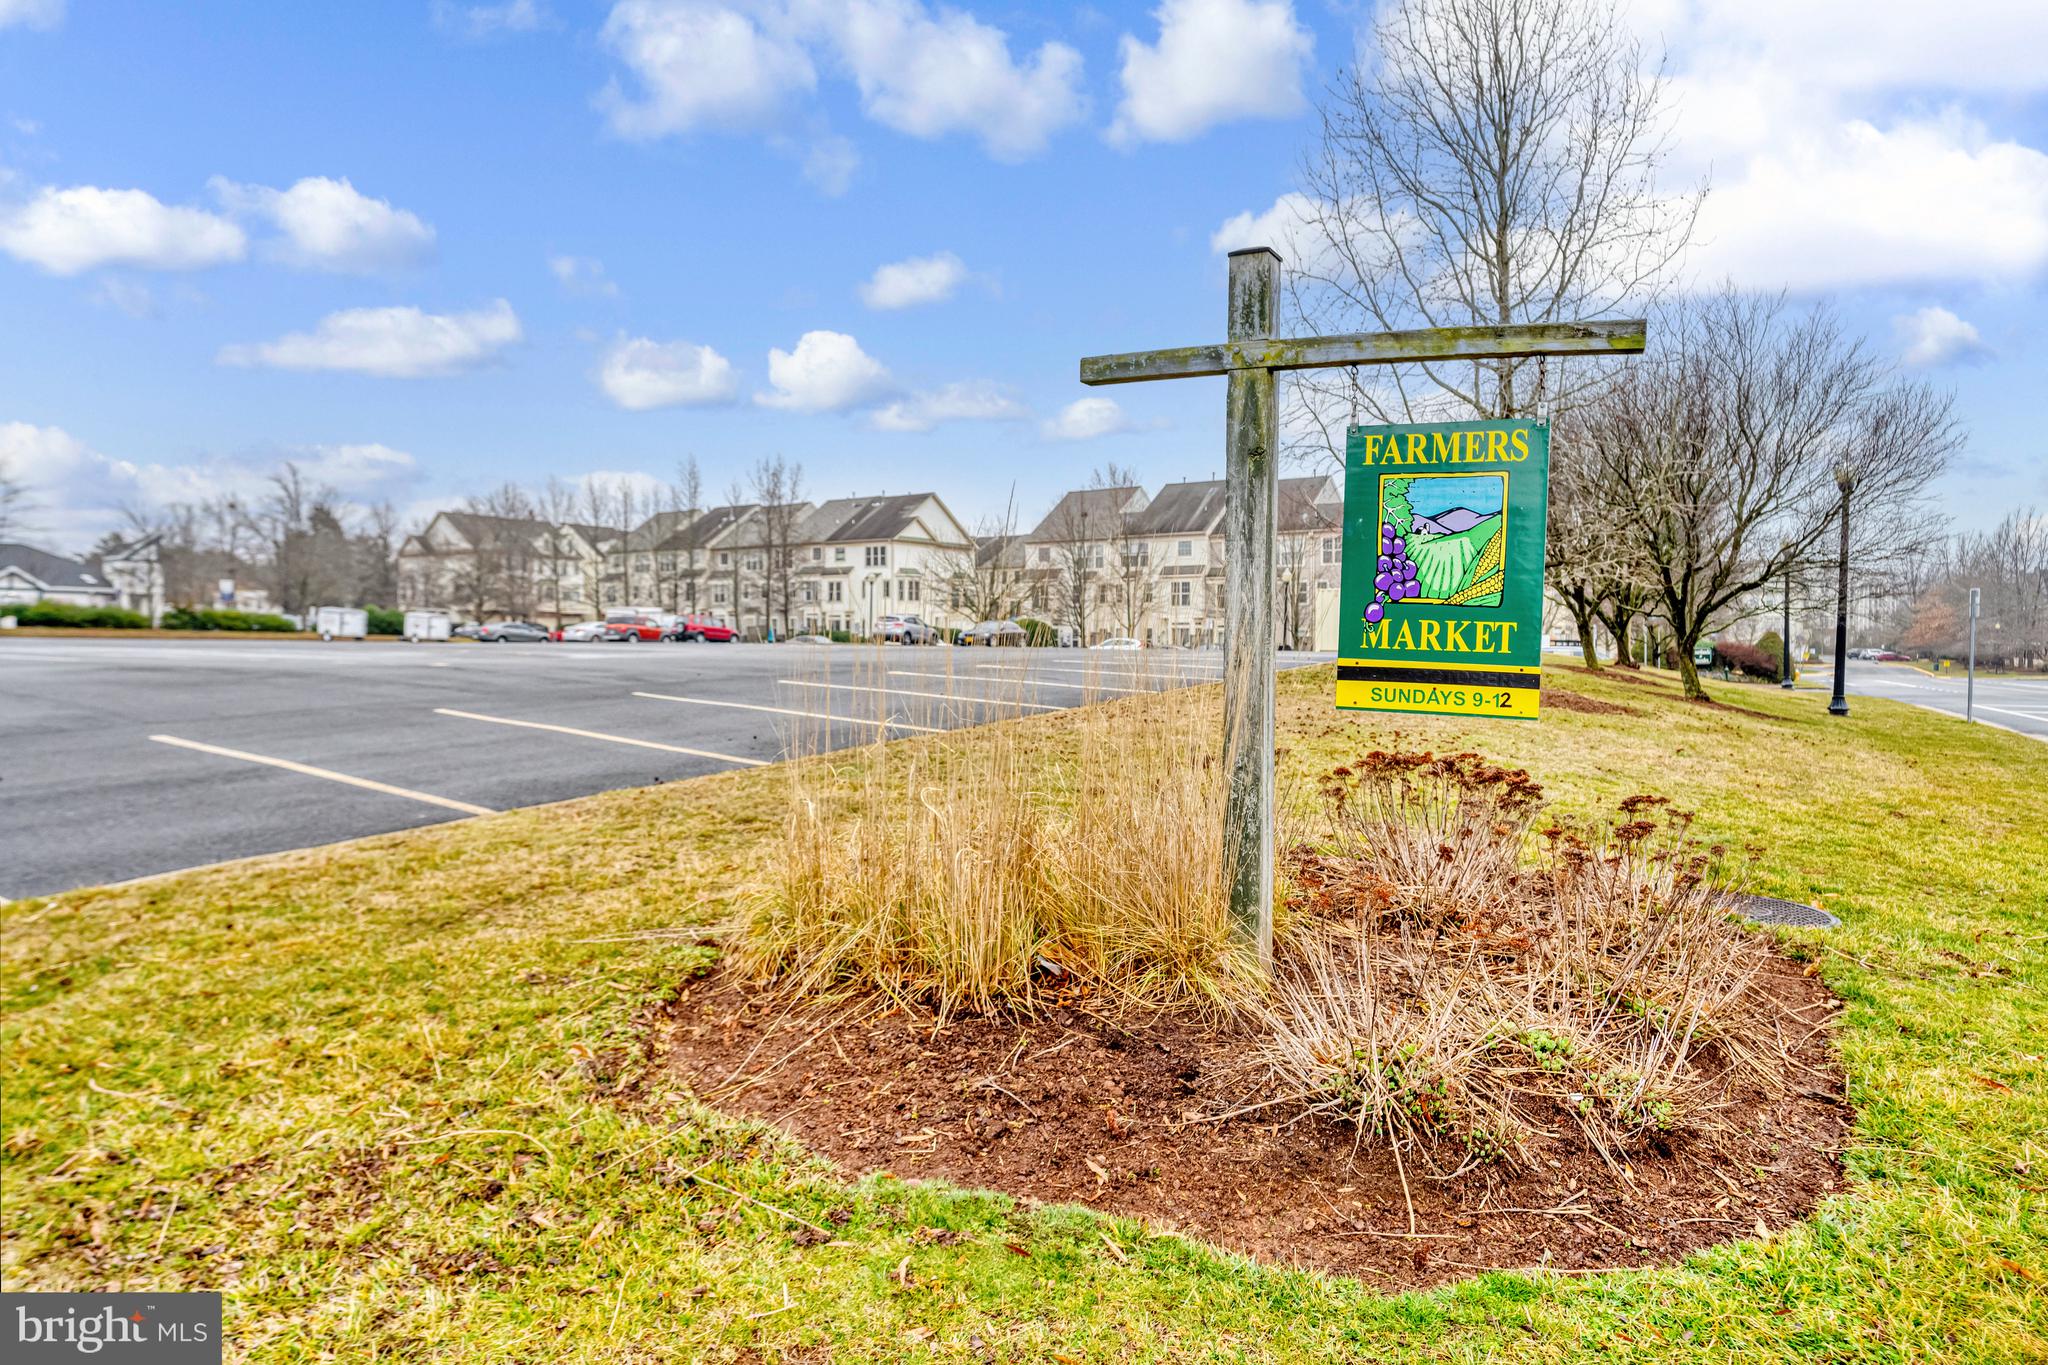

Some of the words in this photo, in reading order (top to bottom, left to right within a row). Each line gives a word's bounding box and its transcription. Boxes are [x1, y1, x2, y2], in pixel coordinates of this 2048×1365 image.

[1362, 429, 1529, 465] FARMERS
[1360, 618, 1518, 654] MARKET
[1370, 686, 1466, 706] SUNDAYS
[1472, 691, 1512, 708] 9-12
